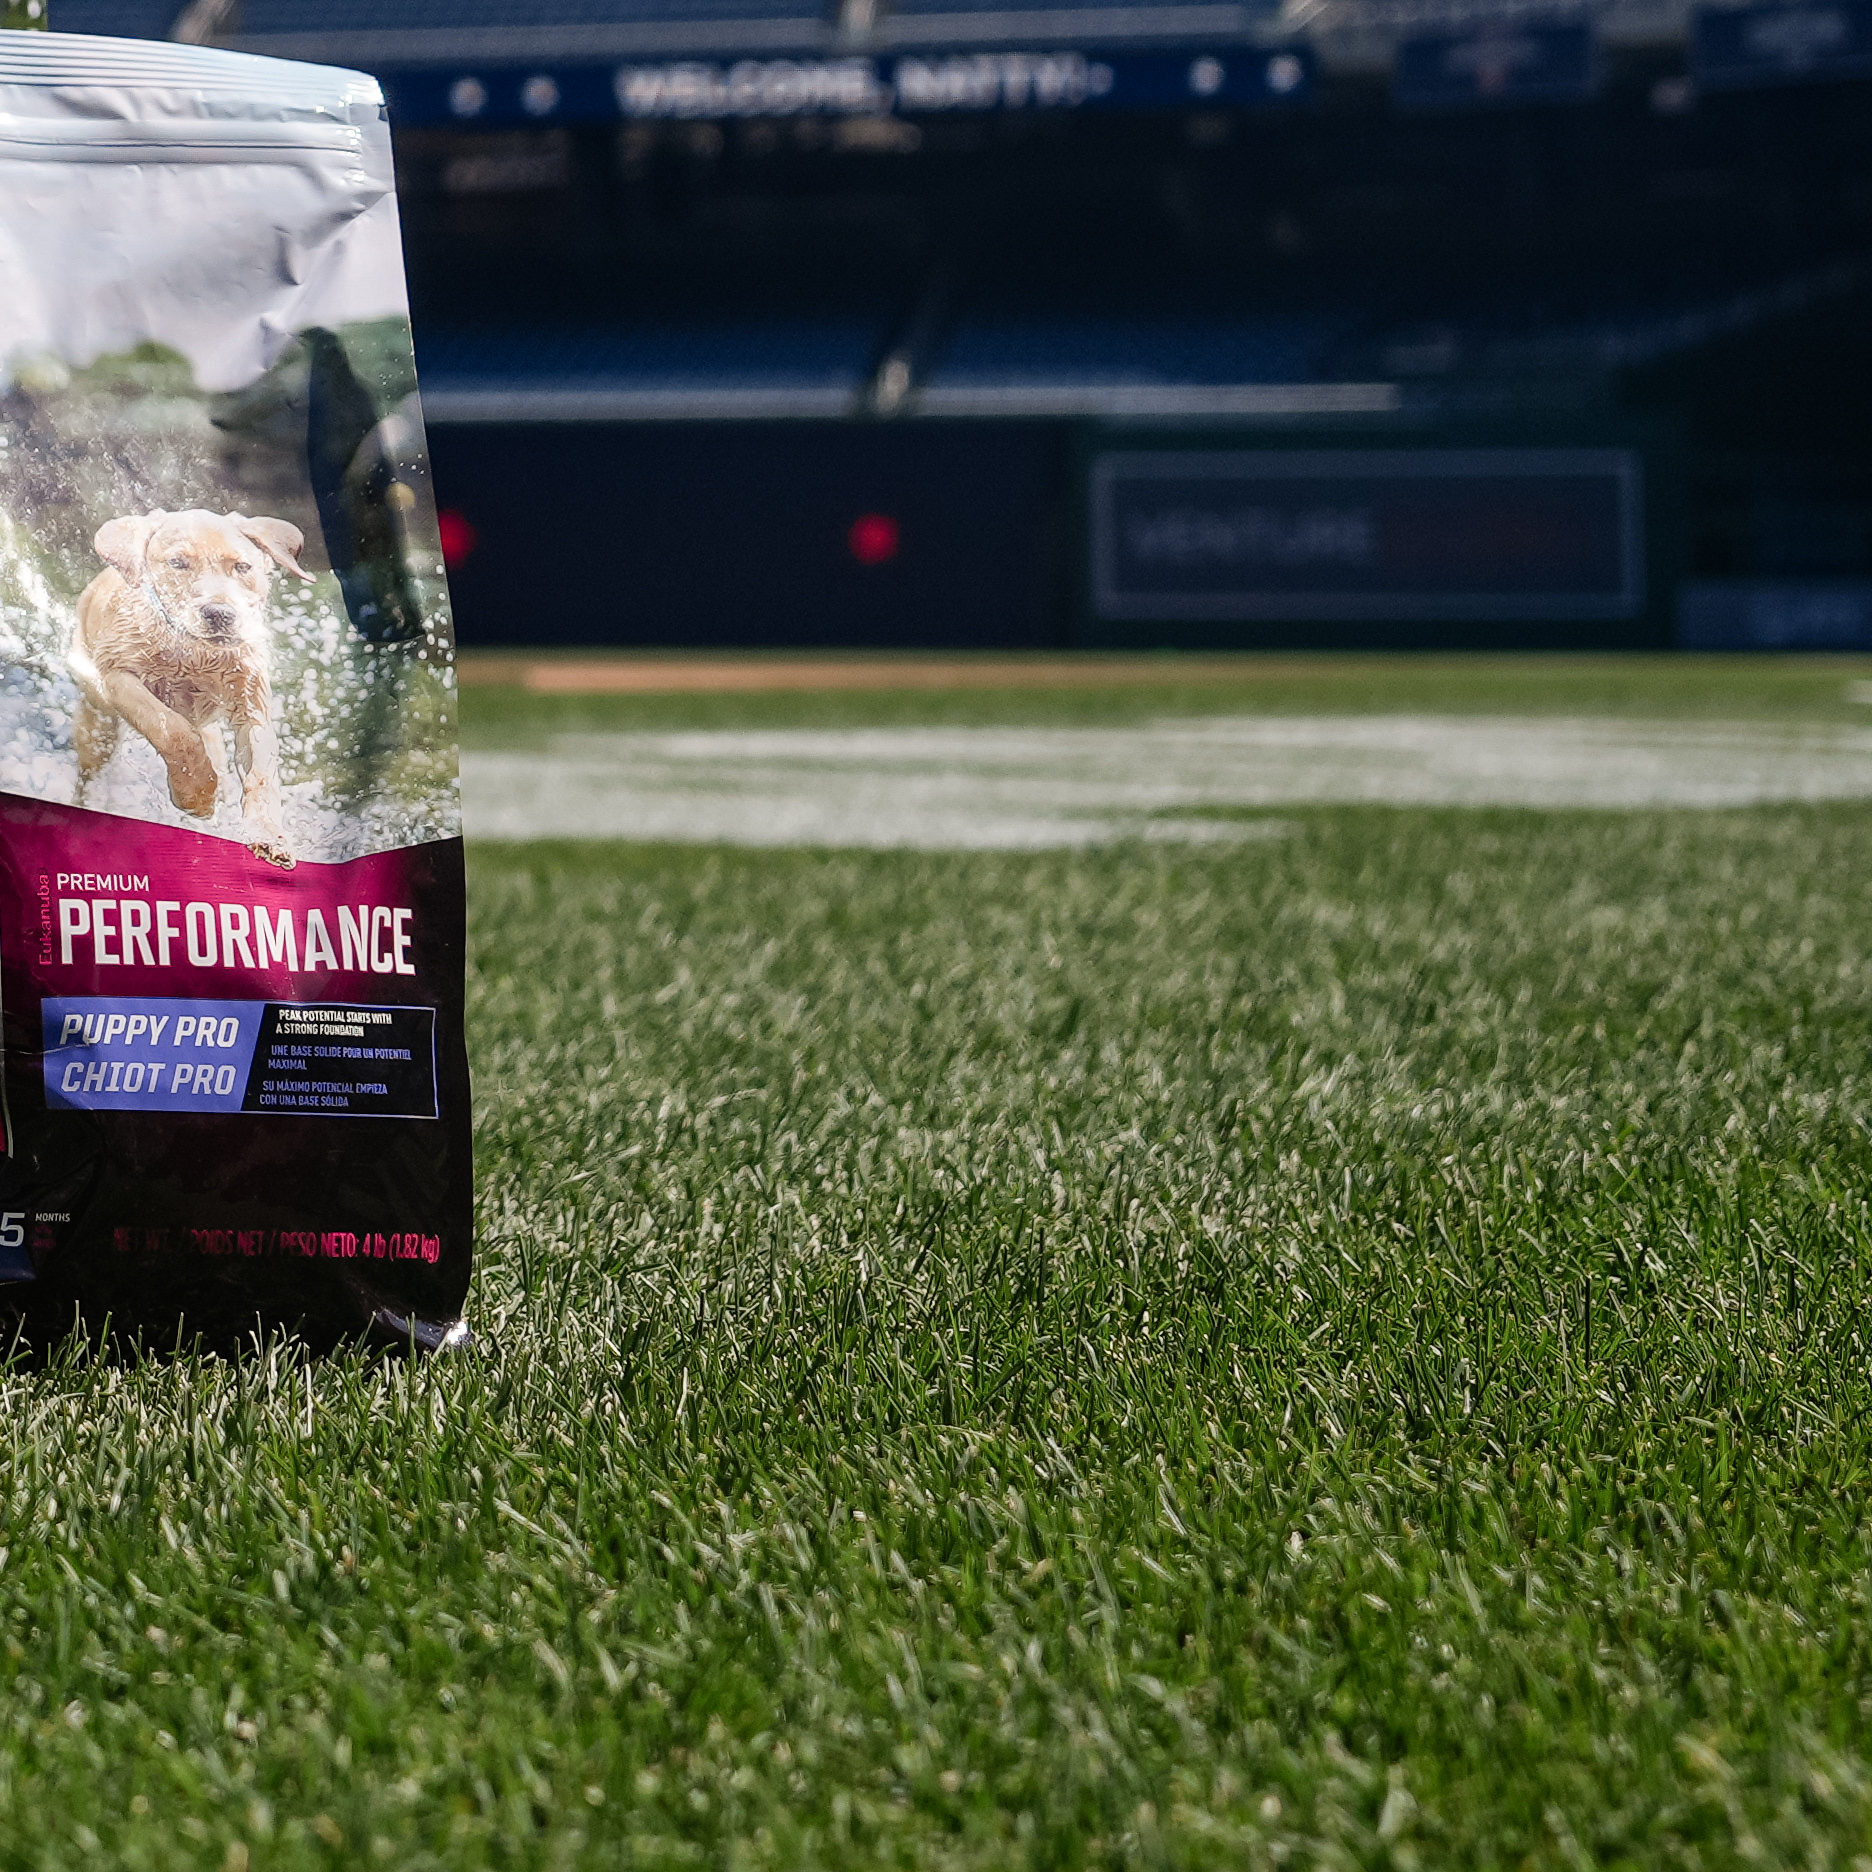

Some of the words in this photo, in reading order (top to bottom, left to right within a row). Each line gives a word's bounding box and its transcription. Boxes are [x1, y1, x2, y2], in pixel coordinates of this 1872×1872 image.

[615, 57, 894, 120] WELCOME,
[56, 872, 150, 893] PREMIUM
[38, 874, 51, 967] Eukanuba
[58, 898, 417, 977] PERFORMANCE
[278, 1008, 302, 1021] PEAK
[304, 1010, 346, 1023] POTENTIAL
[346, 1012, 372, 1025] STARTS
[372, 1013, 393, 1025] WITH
[59, 1012, 166, 1047] PUPPY
[172, 1016, 240, 1049] PRO
[275, 1023, 283, 1034] A
[284, 1023, 319, 1036] STRONG
[271, 1045, 289, 1057] UNE
[290, 1045, 313, 1057] BASE
[314, 1046, 342, 1058] SOLIDE
[268, 1059, 307, 1071] MAXIMAL
[60, 1061, 166, 1094] CHIOT
[170, 1064, 238, 1096] PRO
[262, 1080, 275, 1092] SU
[311, 1082, 355, 1095] POTENCIAL
[259, 1094, 278, 1106] CON
[279, 1095, 297, 1106] UNA
[298, 1095, 320, 1107] BASE
[34, 1212, 71, 1224] MONTHS
[361, 1232, 371, 1257] 4
[373, 1231, 387, 1258] lb
